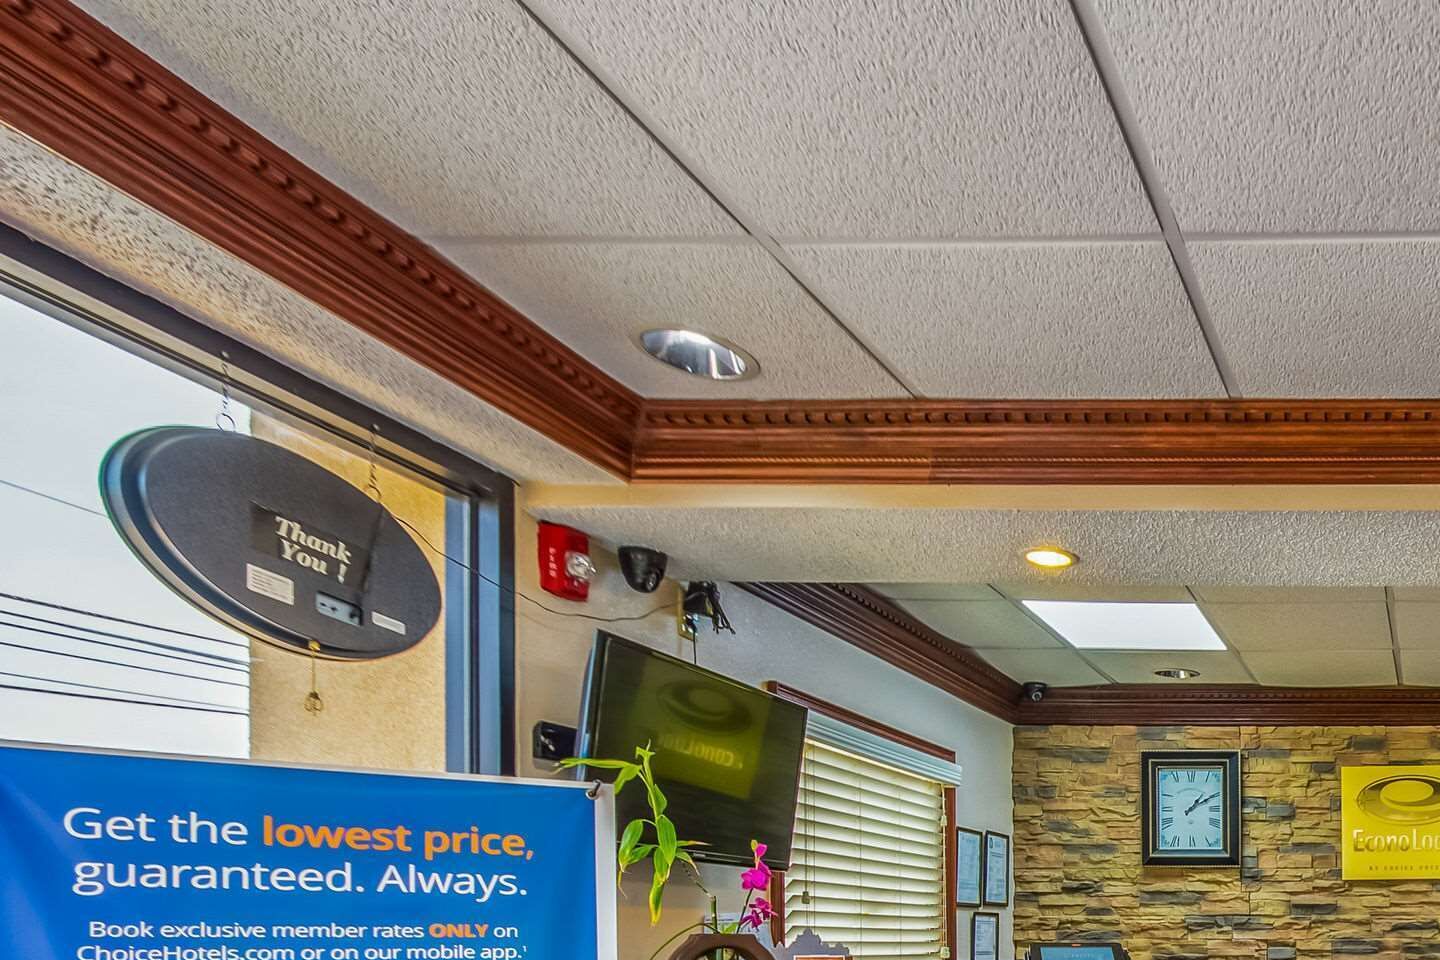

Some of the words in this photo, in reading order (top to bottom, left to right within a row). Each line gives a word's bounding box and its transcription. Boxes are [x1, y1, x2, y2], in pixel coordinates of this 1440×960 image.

[275, 515, 352, 565] Thank
[280, 537, 328, 576] You
[63, 807, 156, 842] Get
[168, 811, 249, 846] the
[263, 815, 412, 852] lowest
[424, 826, 534, 861] price,
[72, 861, 365, 896] guaranteed.
[376, 863, 527, 903] Always.
[88, 920, 154, 938] Book
[159, 921, 266, 938] exclusive
[272, 922, 368, 938] member
[372, 924, 425, 938] rates
[428, 923, 489, 938] ONLY
[493, 925, 519, 938] on
[300, 947, 326, 960] or
[330, 947, 360, 960] on
[364, 947, 402, 960] our
[406, 944, 476, 960] mobile
